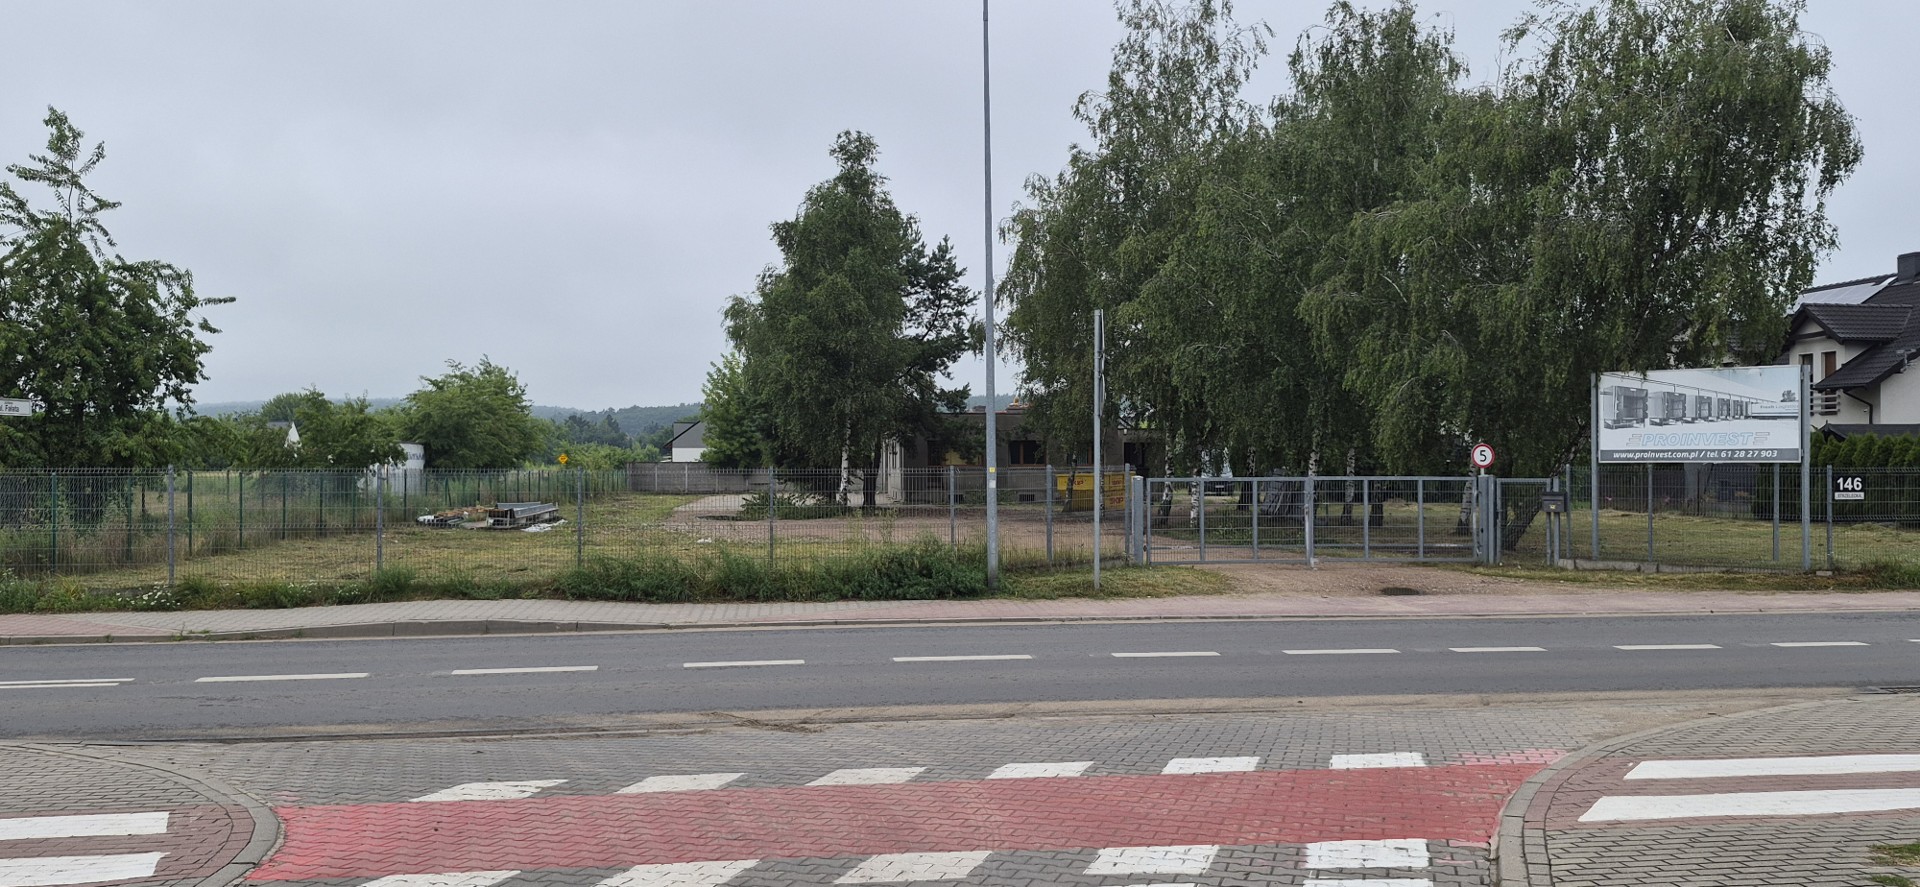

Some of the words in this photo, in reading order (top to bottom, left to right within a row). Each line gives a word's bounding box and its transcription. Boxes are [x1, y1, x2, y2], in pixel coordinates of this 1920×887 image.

[1641, 432, 1754, 446] PROINVEST
[1479, 449, 1487, 462] 5
[1613, 450, 1699, 459] www.proinvest.com.pl
[1706, 450, 1719, 458] tel.
[1720, 450, 1732, 458] 61
[1837, 477, 1862, 490] 146
